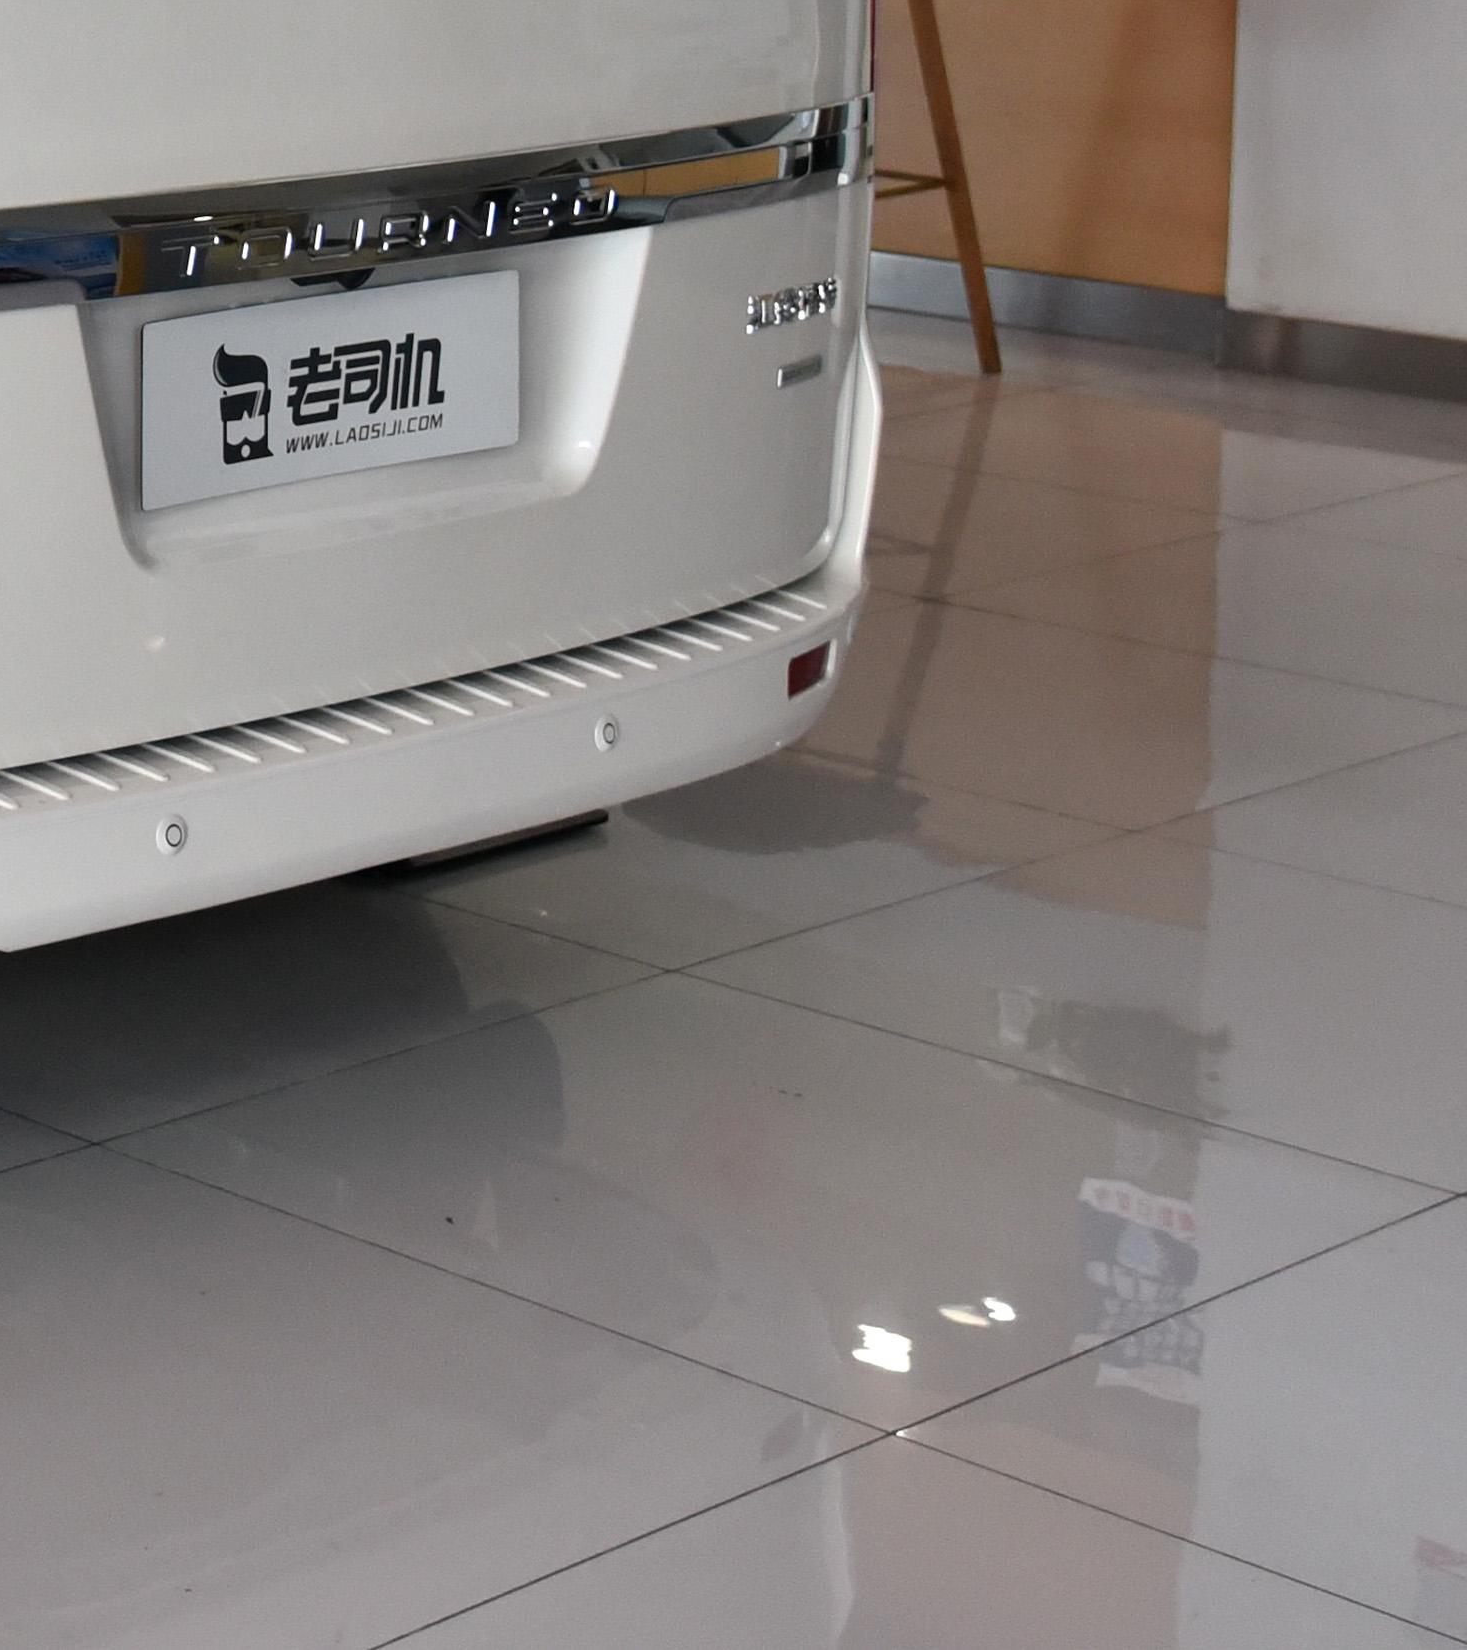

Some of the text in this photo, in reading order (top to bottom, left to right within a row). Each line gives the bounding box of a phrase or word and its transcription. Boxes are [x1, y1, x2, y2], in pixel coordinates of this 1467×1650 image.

[162, 185, 616, 279] TOURNEO
[286, 332, 446, 427] 老司机
[285, 413, 445, 455] WWW.LAOSIJI.COM
